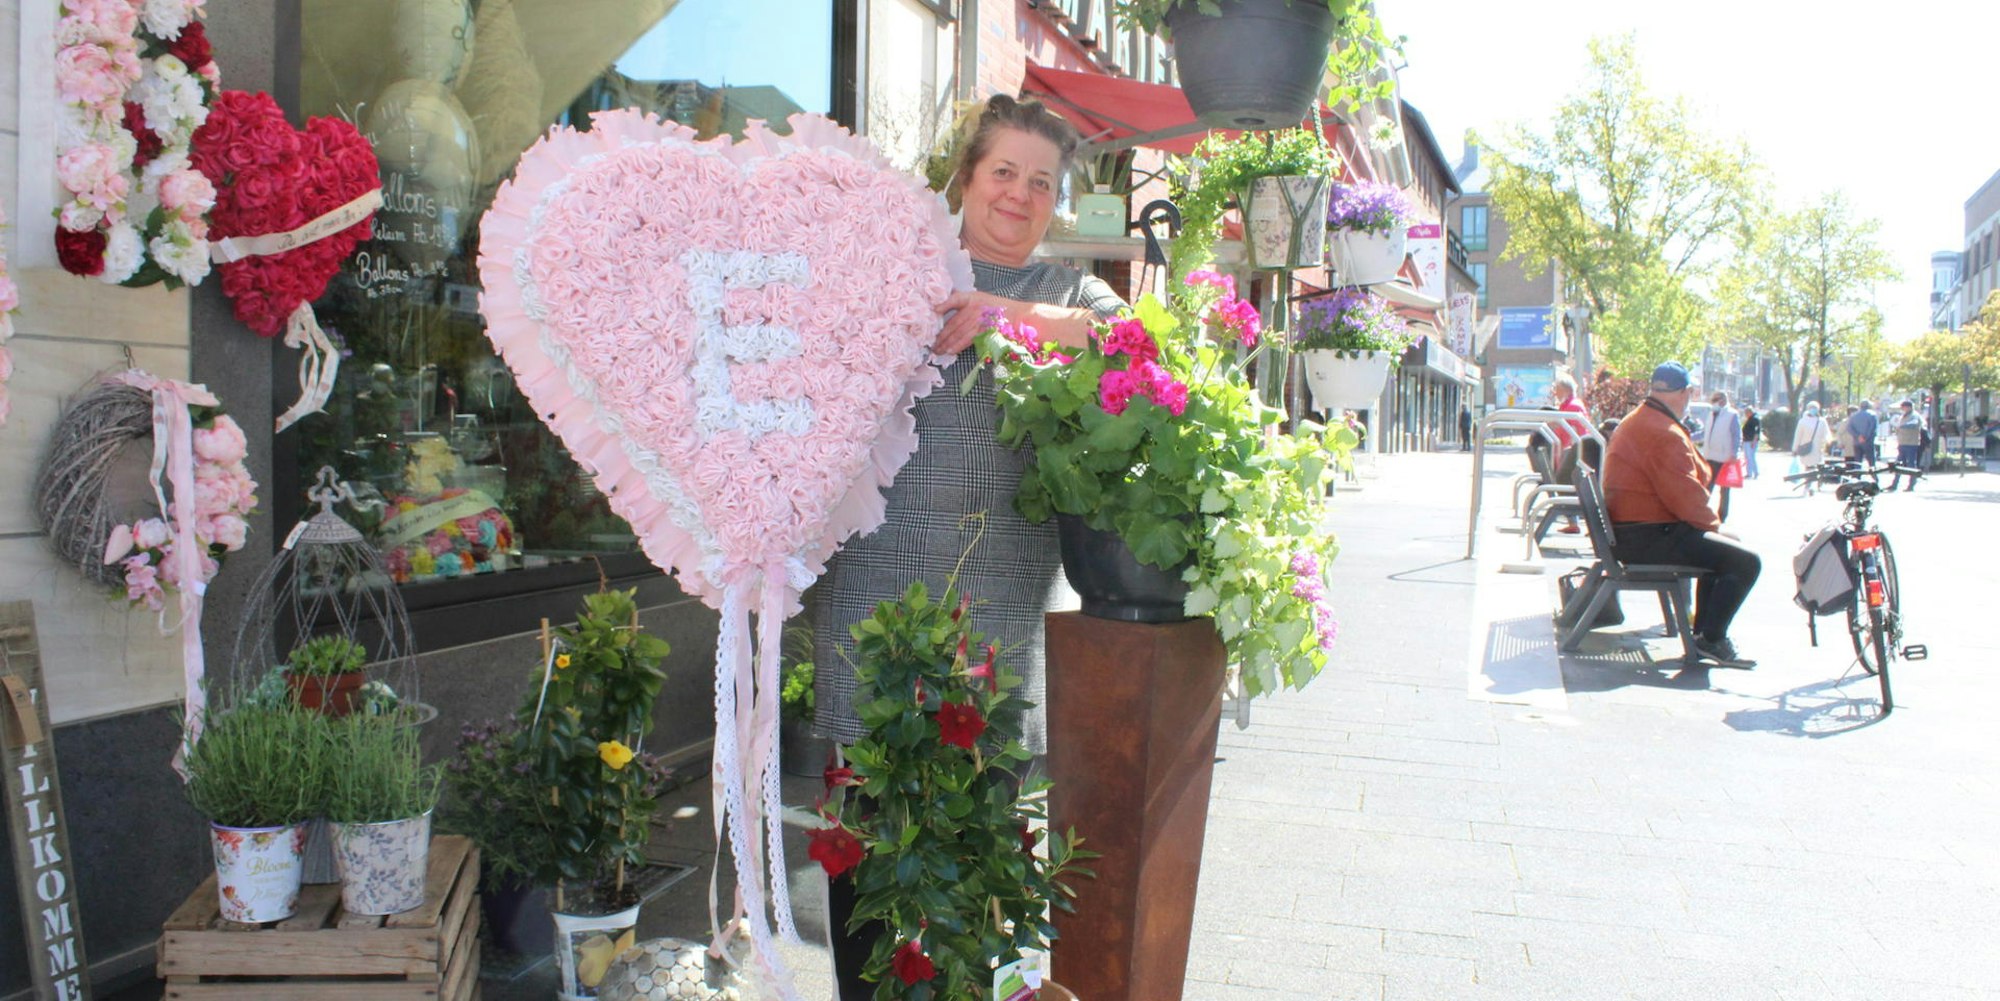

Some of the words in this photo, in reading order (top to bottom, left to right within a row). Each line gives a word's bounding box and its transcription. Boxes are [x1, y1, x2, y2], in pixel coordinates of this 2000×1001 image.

[383, 171, 437, 218] allons
[355, 251, 409, 289] Ballons
[679, 250, 816, 441] E
[18, 688, 82, 1001] LLKOMME
